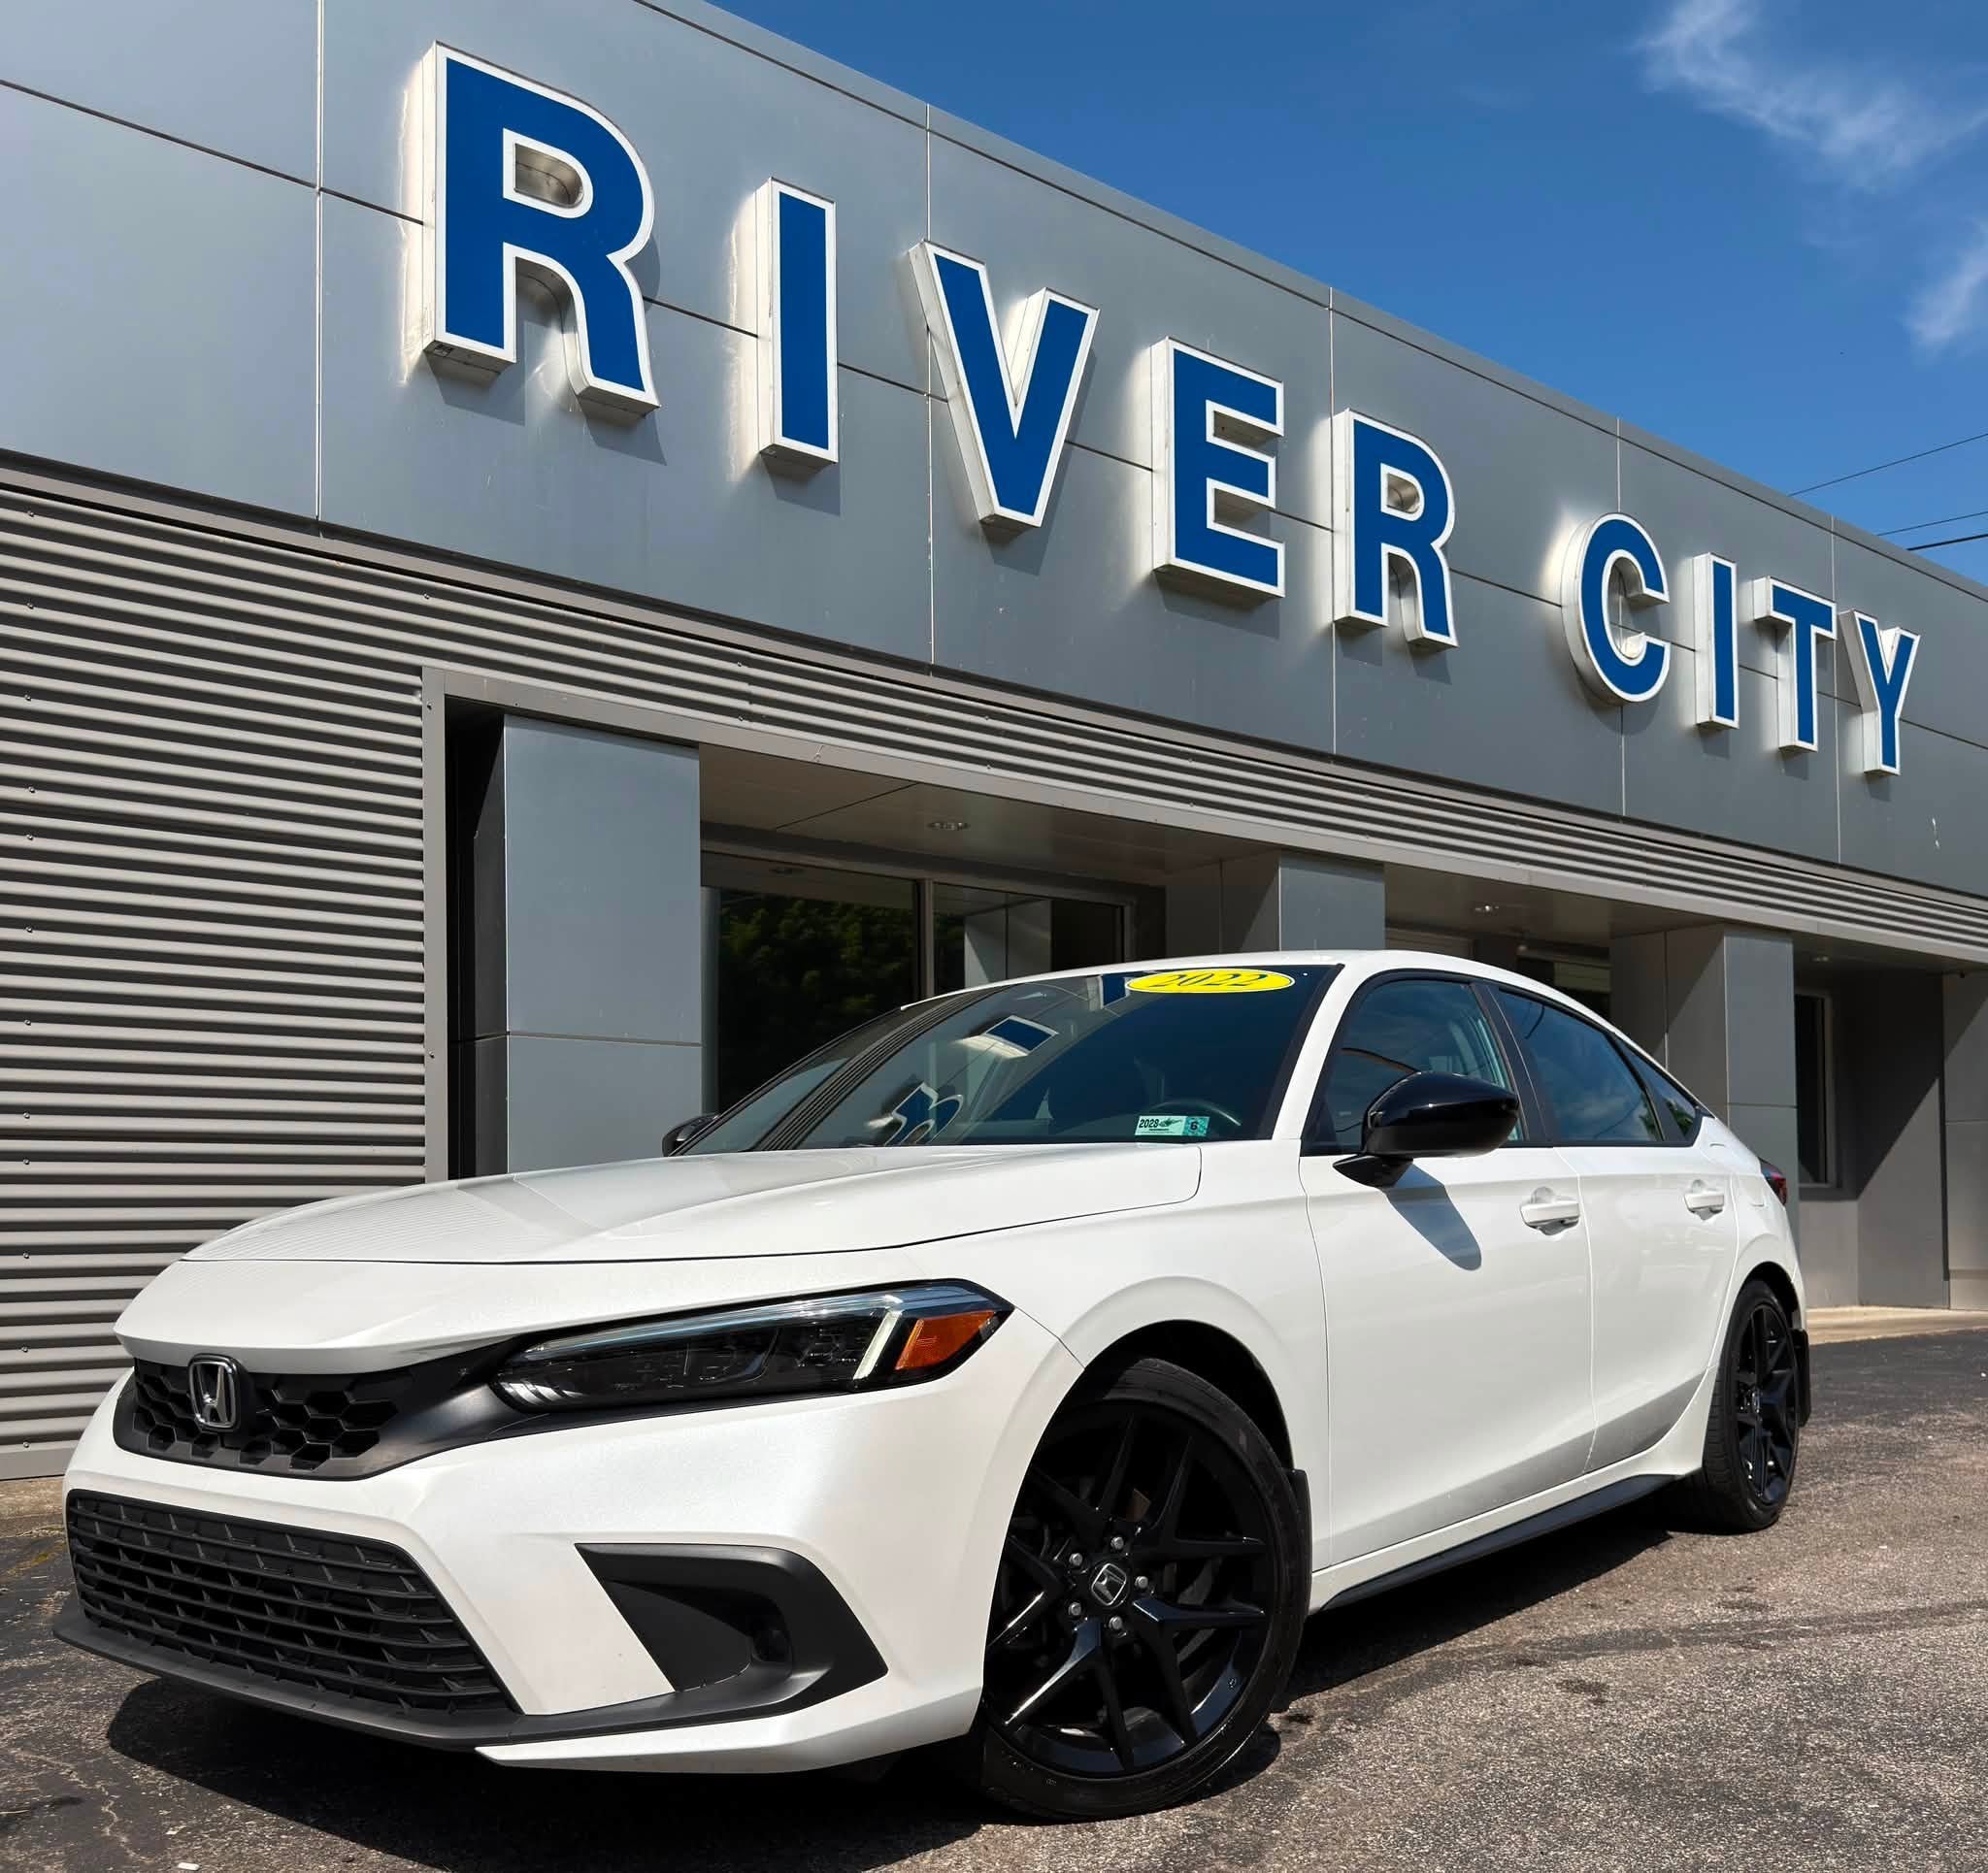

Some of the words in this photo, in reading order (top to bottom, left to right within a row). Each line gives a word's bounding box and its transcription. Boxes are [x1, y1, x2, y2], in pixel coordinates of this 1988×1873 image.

[431, 42, 1458, 648] RIVER
[1569, 512, 1921, 775] CITY
[1148, 972, 1269, 988] 2022
[1190, 1121, 1198, 1131] 6
